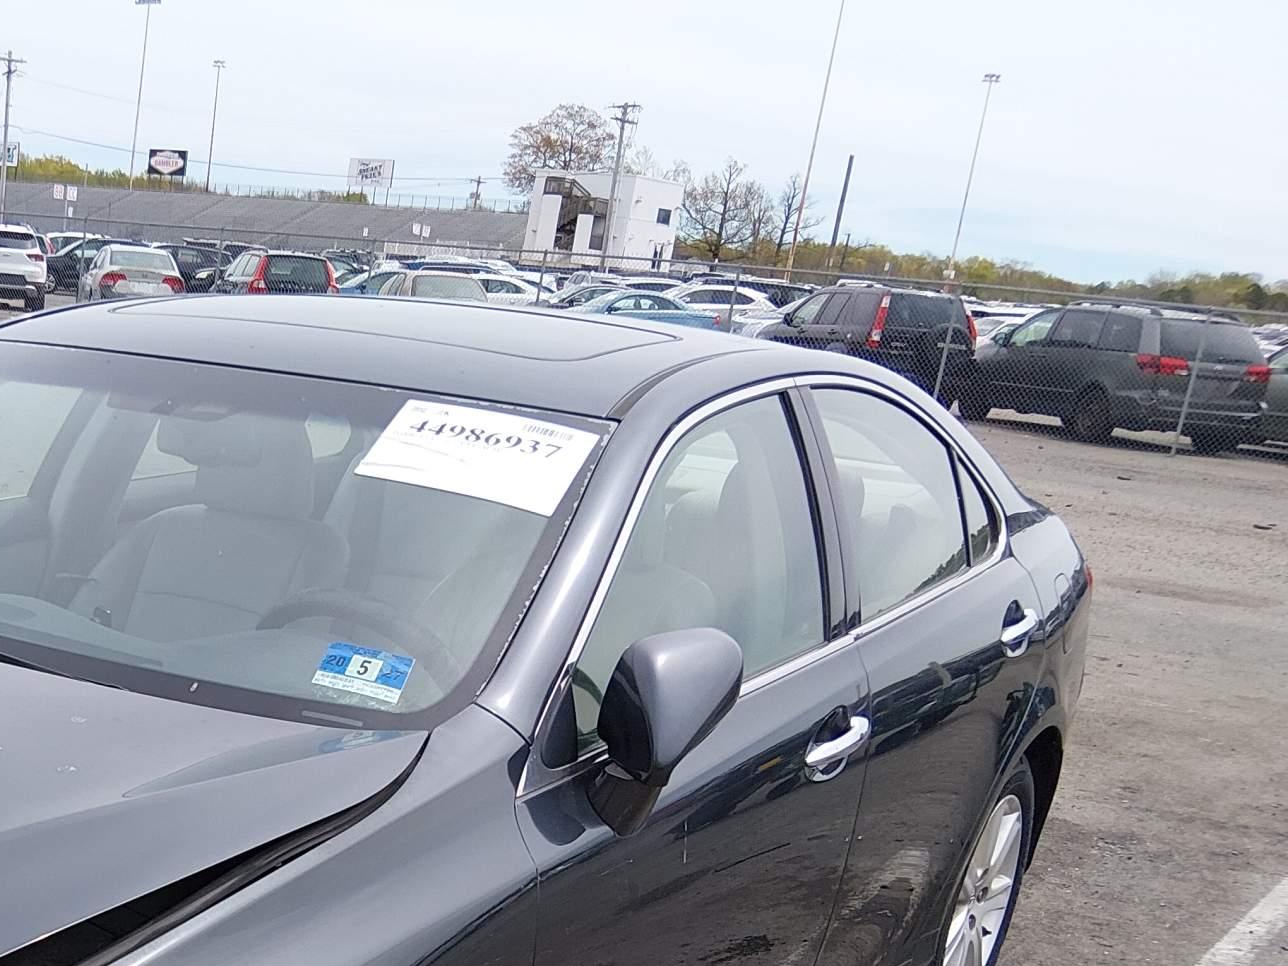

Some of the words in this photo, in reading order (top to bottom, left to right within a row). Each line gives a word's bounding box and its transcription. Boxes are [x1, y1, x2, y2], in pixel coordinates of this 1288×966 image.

[409, 420, 563, 458] 44986937
[325, 654, 347, 668] 20
[356, 659, 373, 676] 5
